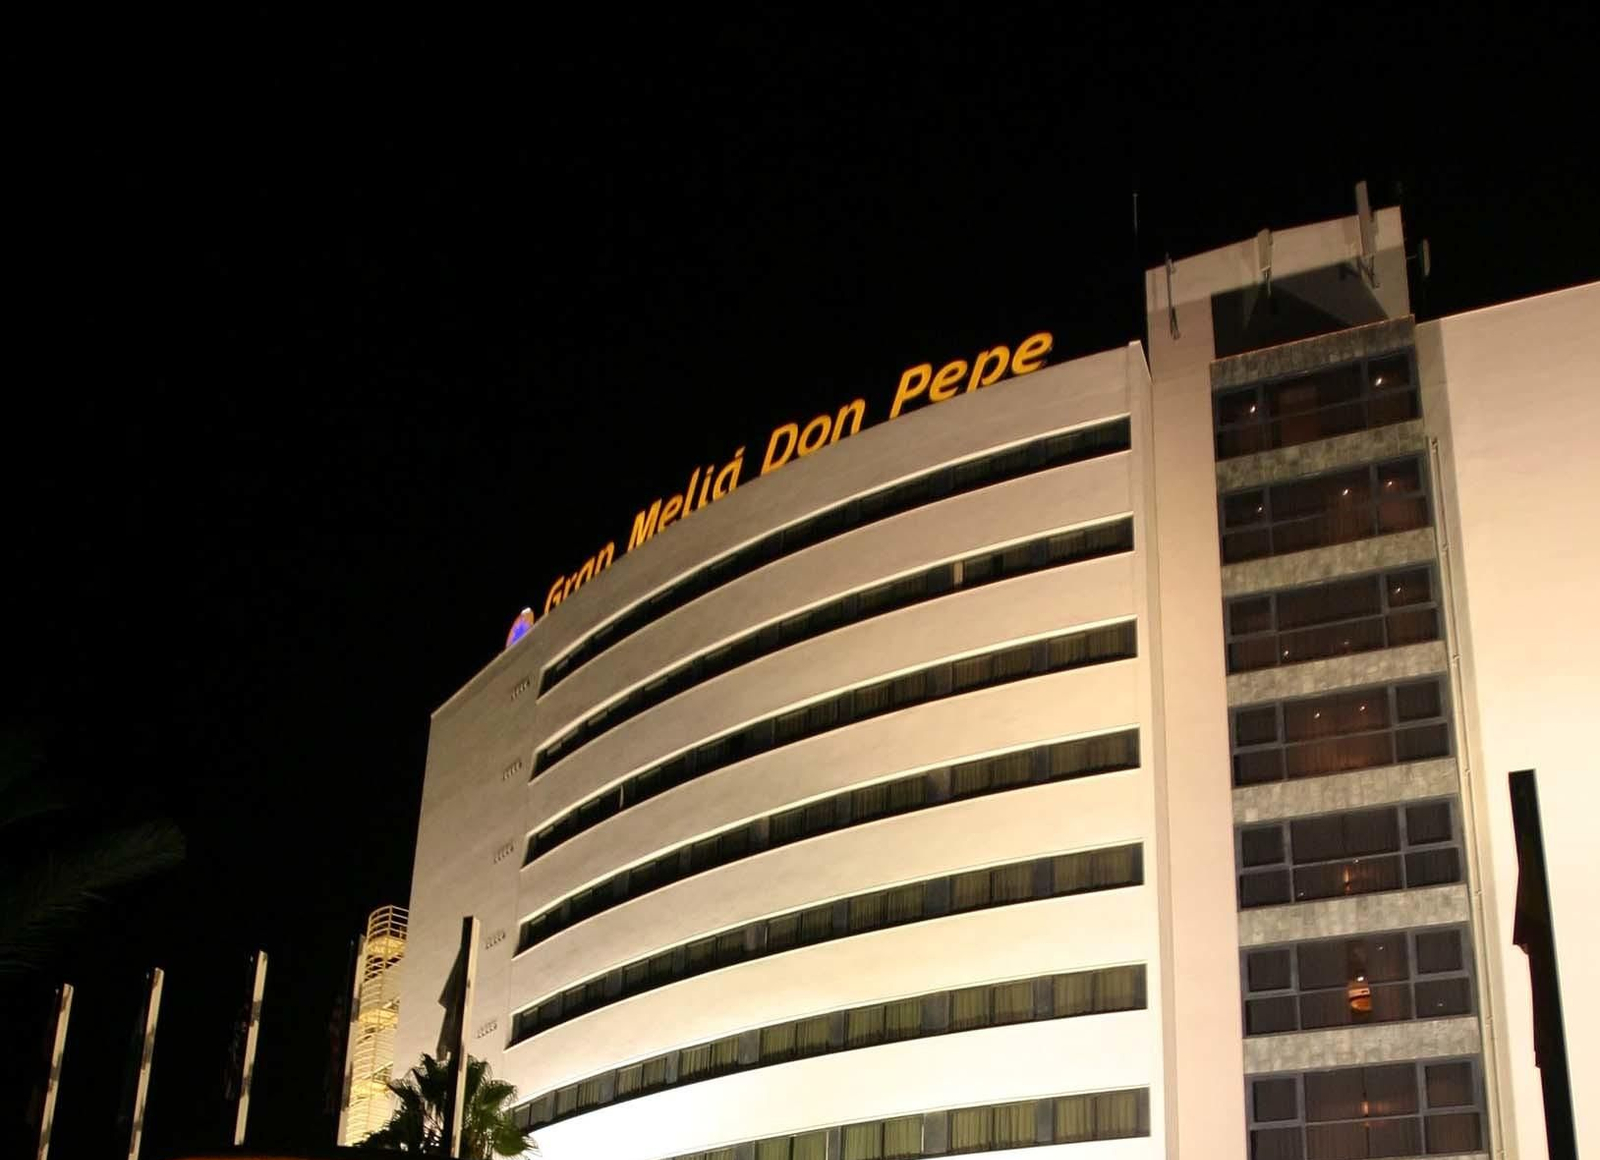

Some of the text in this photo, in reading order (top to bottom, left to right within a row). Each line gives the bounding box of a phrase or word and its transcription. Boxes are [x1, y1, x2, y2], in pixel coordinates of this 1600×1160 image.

[543, 332, 1054, 615] Gran Meliá Don Pepe
